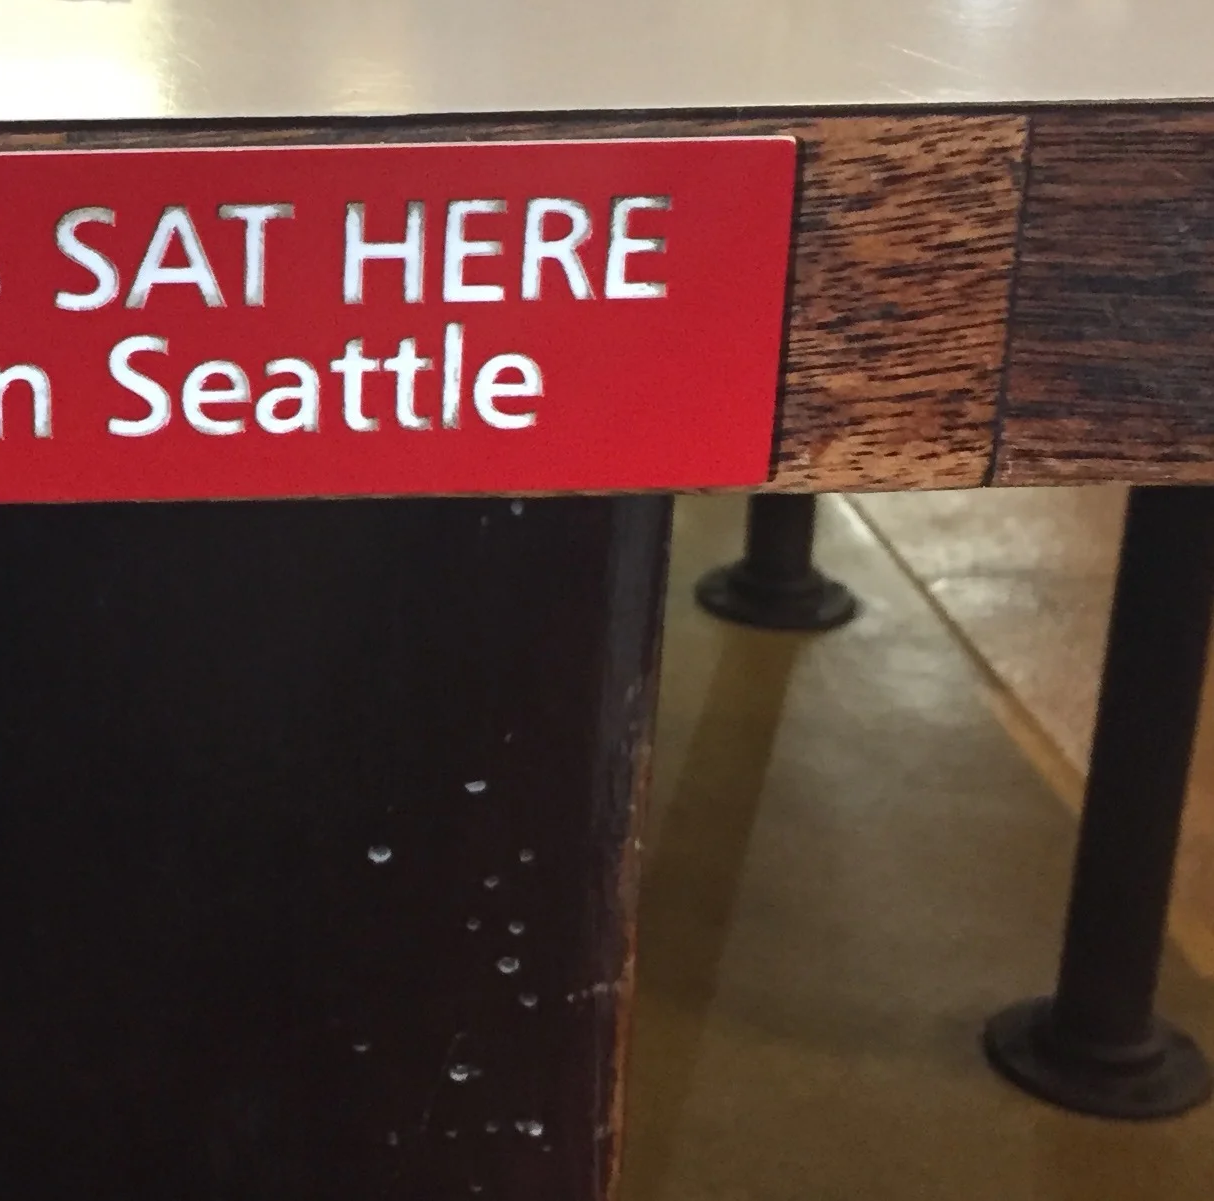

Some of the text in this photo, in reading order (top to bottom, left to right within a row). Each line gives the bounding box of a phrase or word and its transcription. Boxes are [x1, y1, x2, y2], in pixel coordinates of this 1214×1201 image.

[55, 203, 295, 311] SAT
[343, 196, 672, 304] HERE
[108, 322, 544, 437] Seattle
